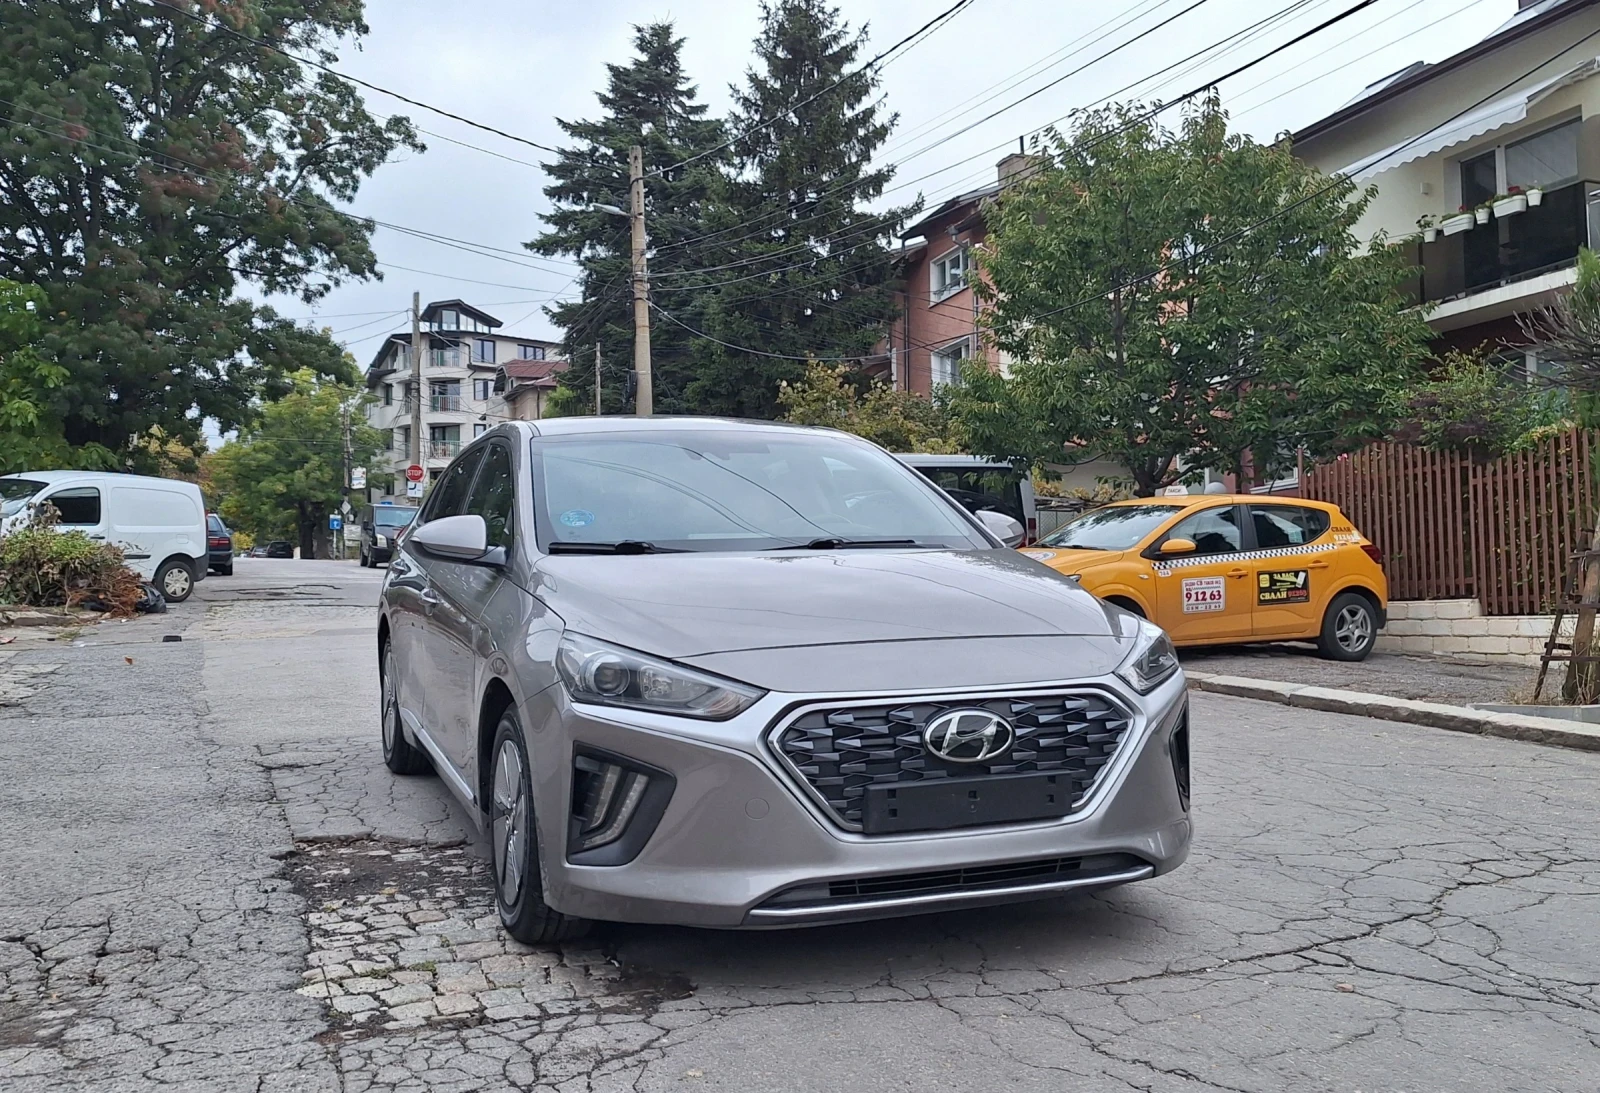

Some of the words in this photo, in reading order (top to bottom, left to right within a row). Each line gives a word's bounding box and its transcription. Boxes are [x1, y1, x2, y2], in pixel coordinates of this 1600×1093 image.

[1185, 592, 1192, 602] 9
[1194, 591, 1207, 602] 12
[1209, 589, 1222, 601] 63
